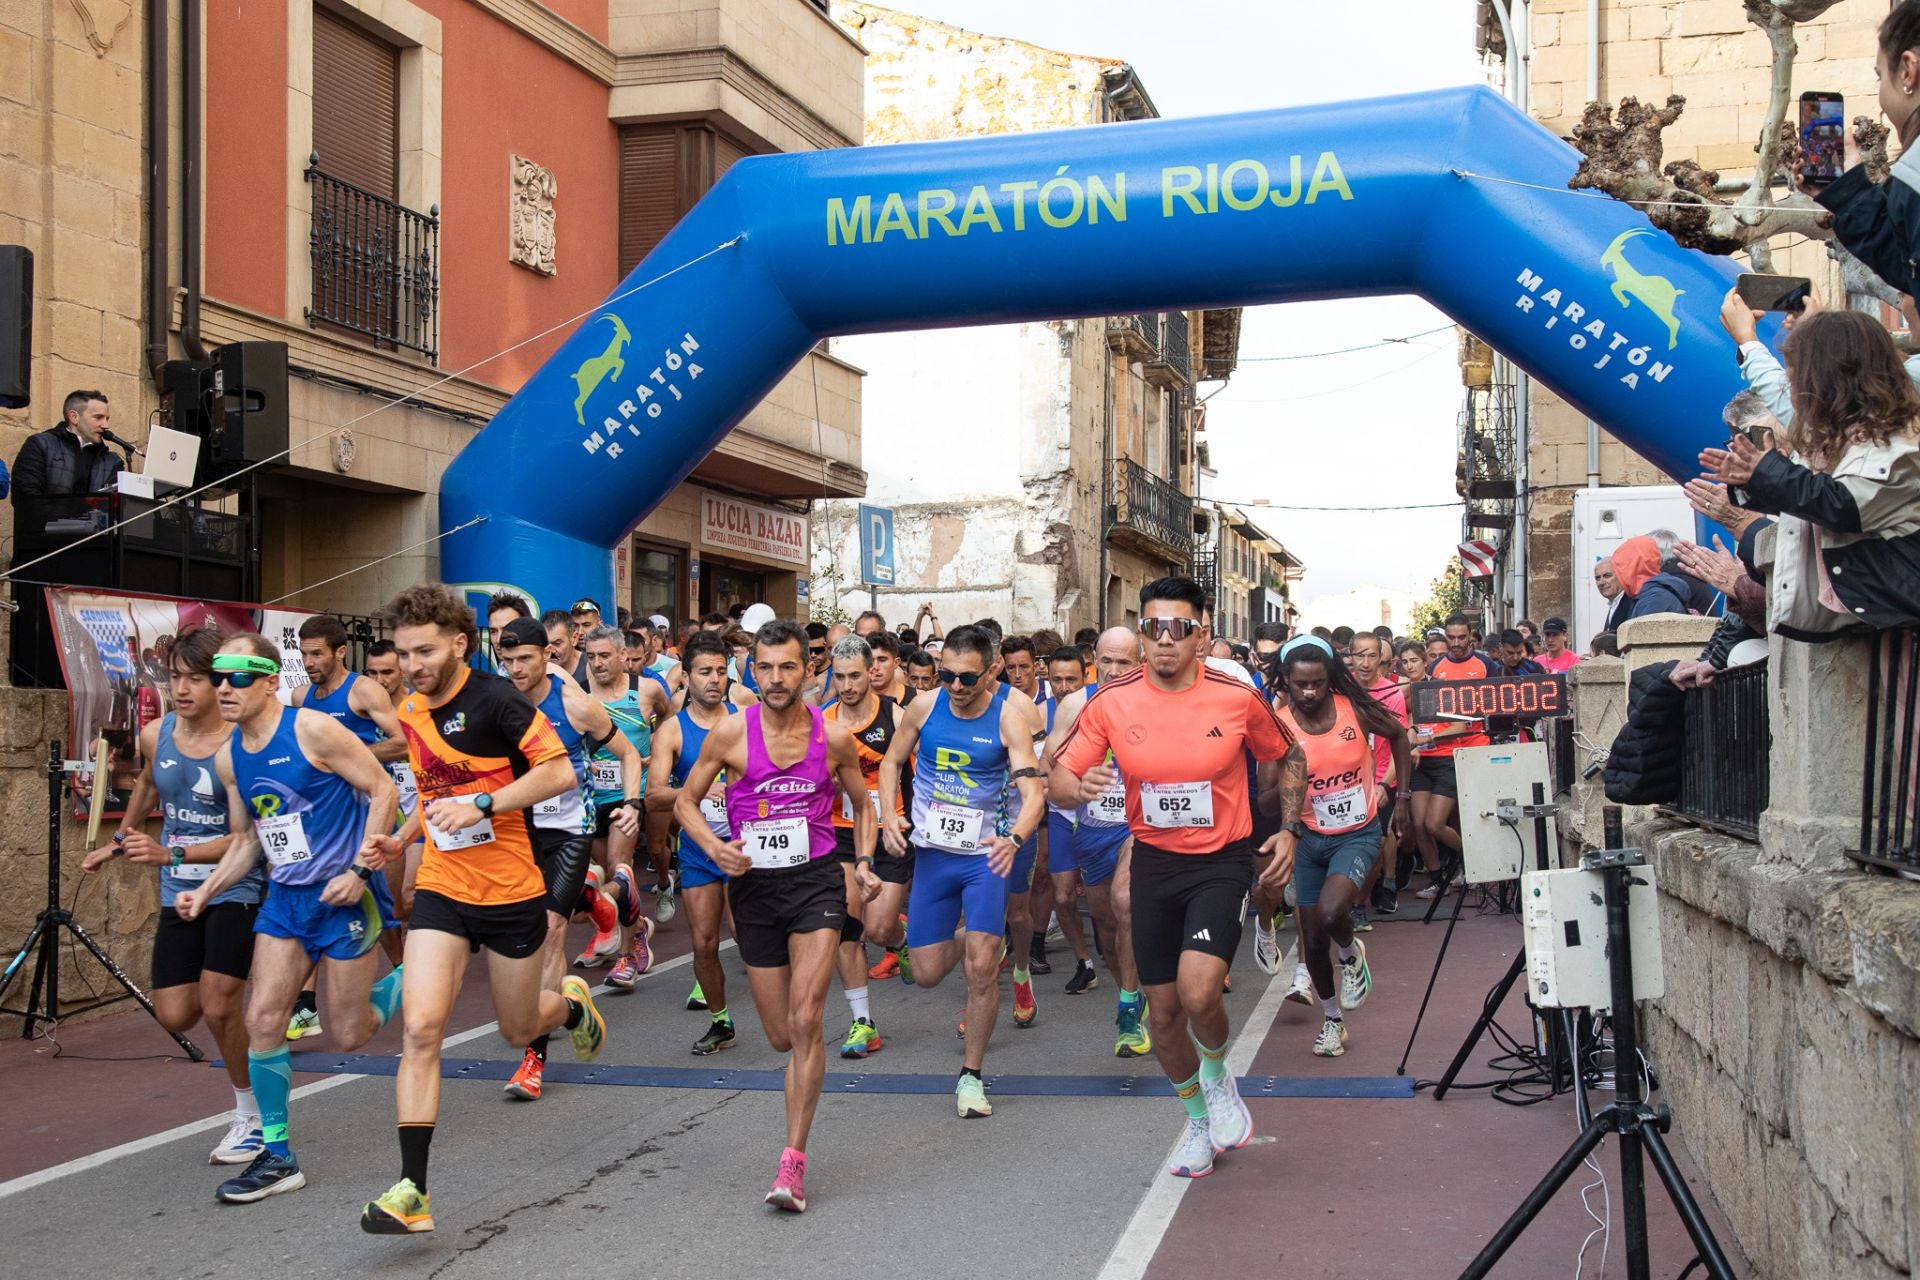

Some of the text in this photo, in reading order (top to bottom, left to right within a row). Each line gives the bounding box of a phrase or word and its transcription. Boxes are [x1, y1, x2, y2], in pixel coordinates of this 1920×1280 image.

[826, 151, 1355, 247] MARATÓN RIOJA
[1516, 268, 1674, 383] MARATÓN
[1515, 294, 1640, 391] RIOJA
[582, 332, 700, 455] MARATÓN
[605, 363, 705, 460] RIOJA
[706, 498, 803, 548] LUCIA BAZAR
[871, 513, 886, 576] P
[1438, 681, 1558, 715] 00:00:02
[1307, 766, 1361, 790] Ferrer
[934, 782, 970, 797] MARATÓN
[543, 805, 558, 813] SDi
[1100, 796, 1125, 808] 298
[1158, 797, 1191, 811] 652
[1327, 800, 1352, 816] 647
[177, 808, 225, 825] Chiruca
[1191, 816, 1211, 825] SDi
[940, 817, 965, 834] 133
[265, 831, 288, 848] 129
[757, 834, 789, 850] 749
[960, 840, 976, 849] SDi
[789, 854, 807, 864] SDi
